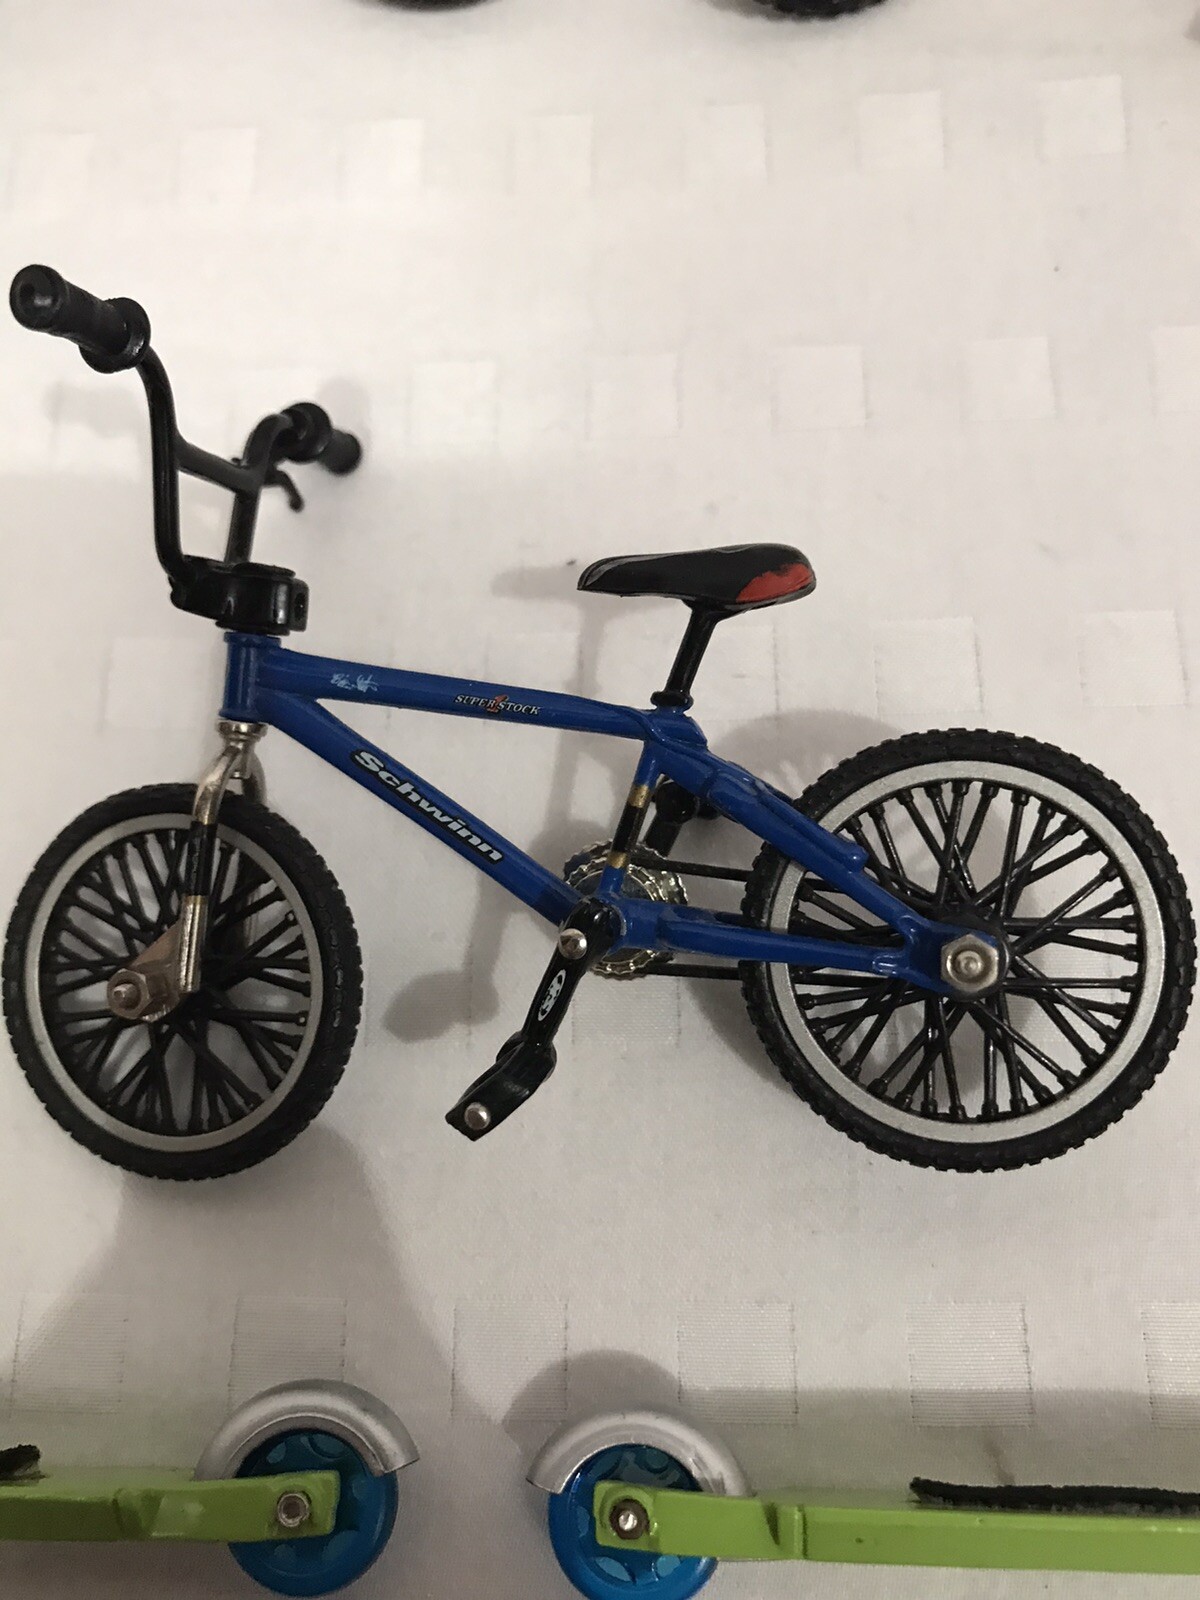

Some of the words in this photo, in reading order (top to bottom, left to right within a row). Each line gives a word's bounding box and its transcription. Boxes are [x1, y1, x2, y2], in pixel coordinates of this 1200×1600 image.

[454, 694, 495, 708] SUPER
[498, 701, 541, 715] STOCK
[353, 750, 503, 863] Schwinn
